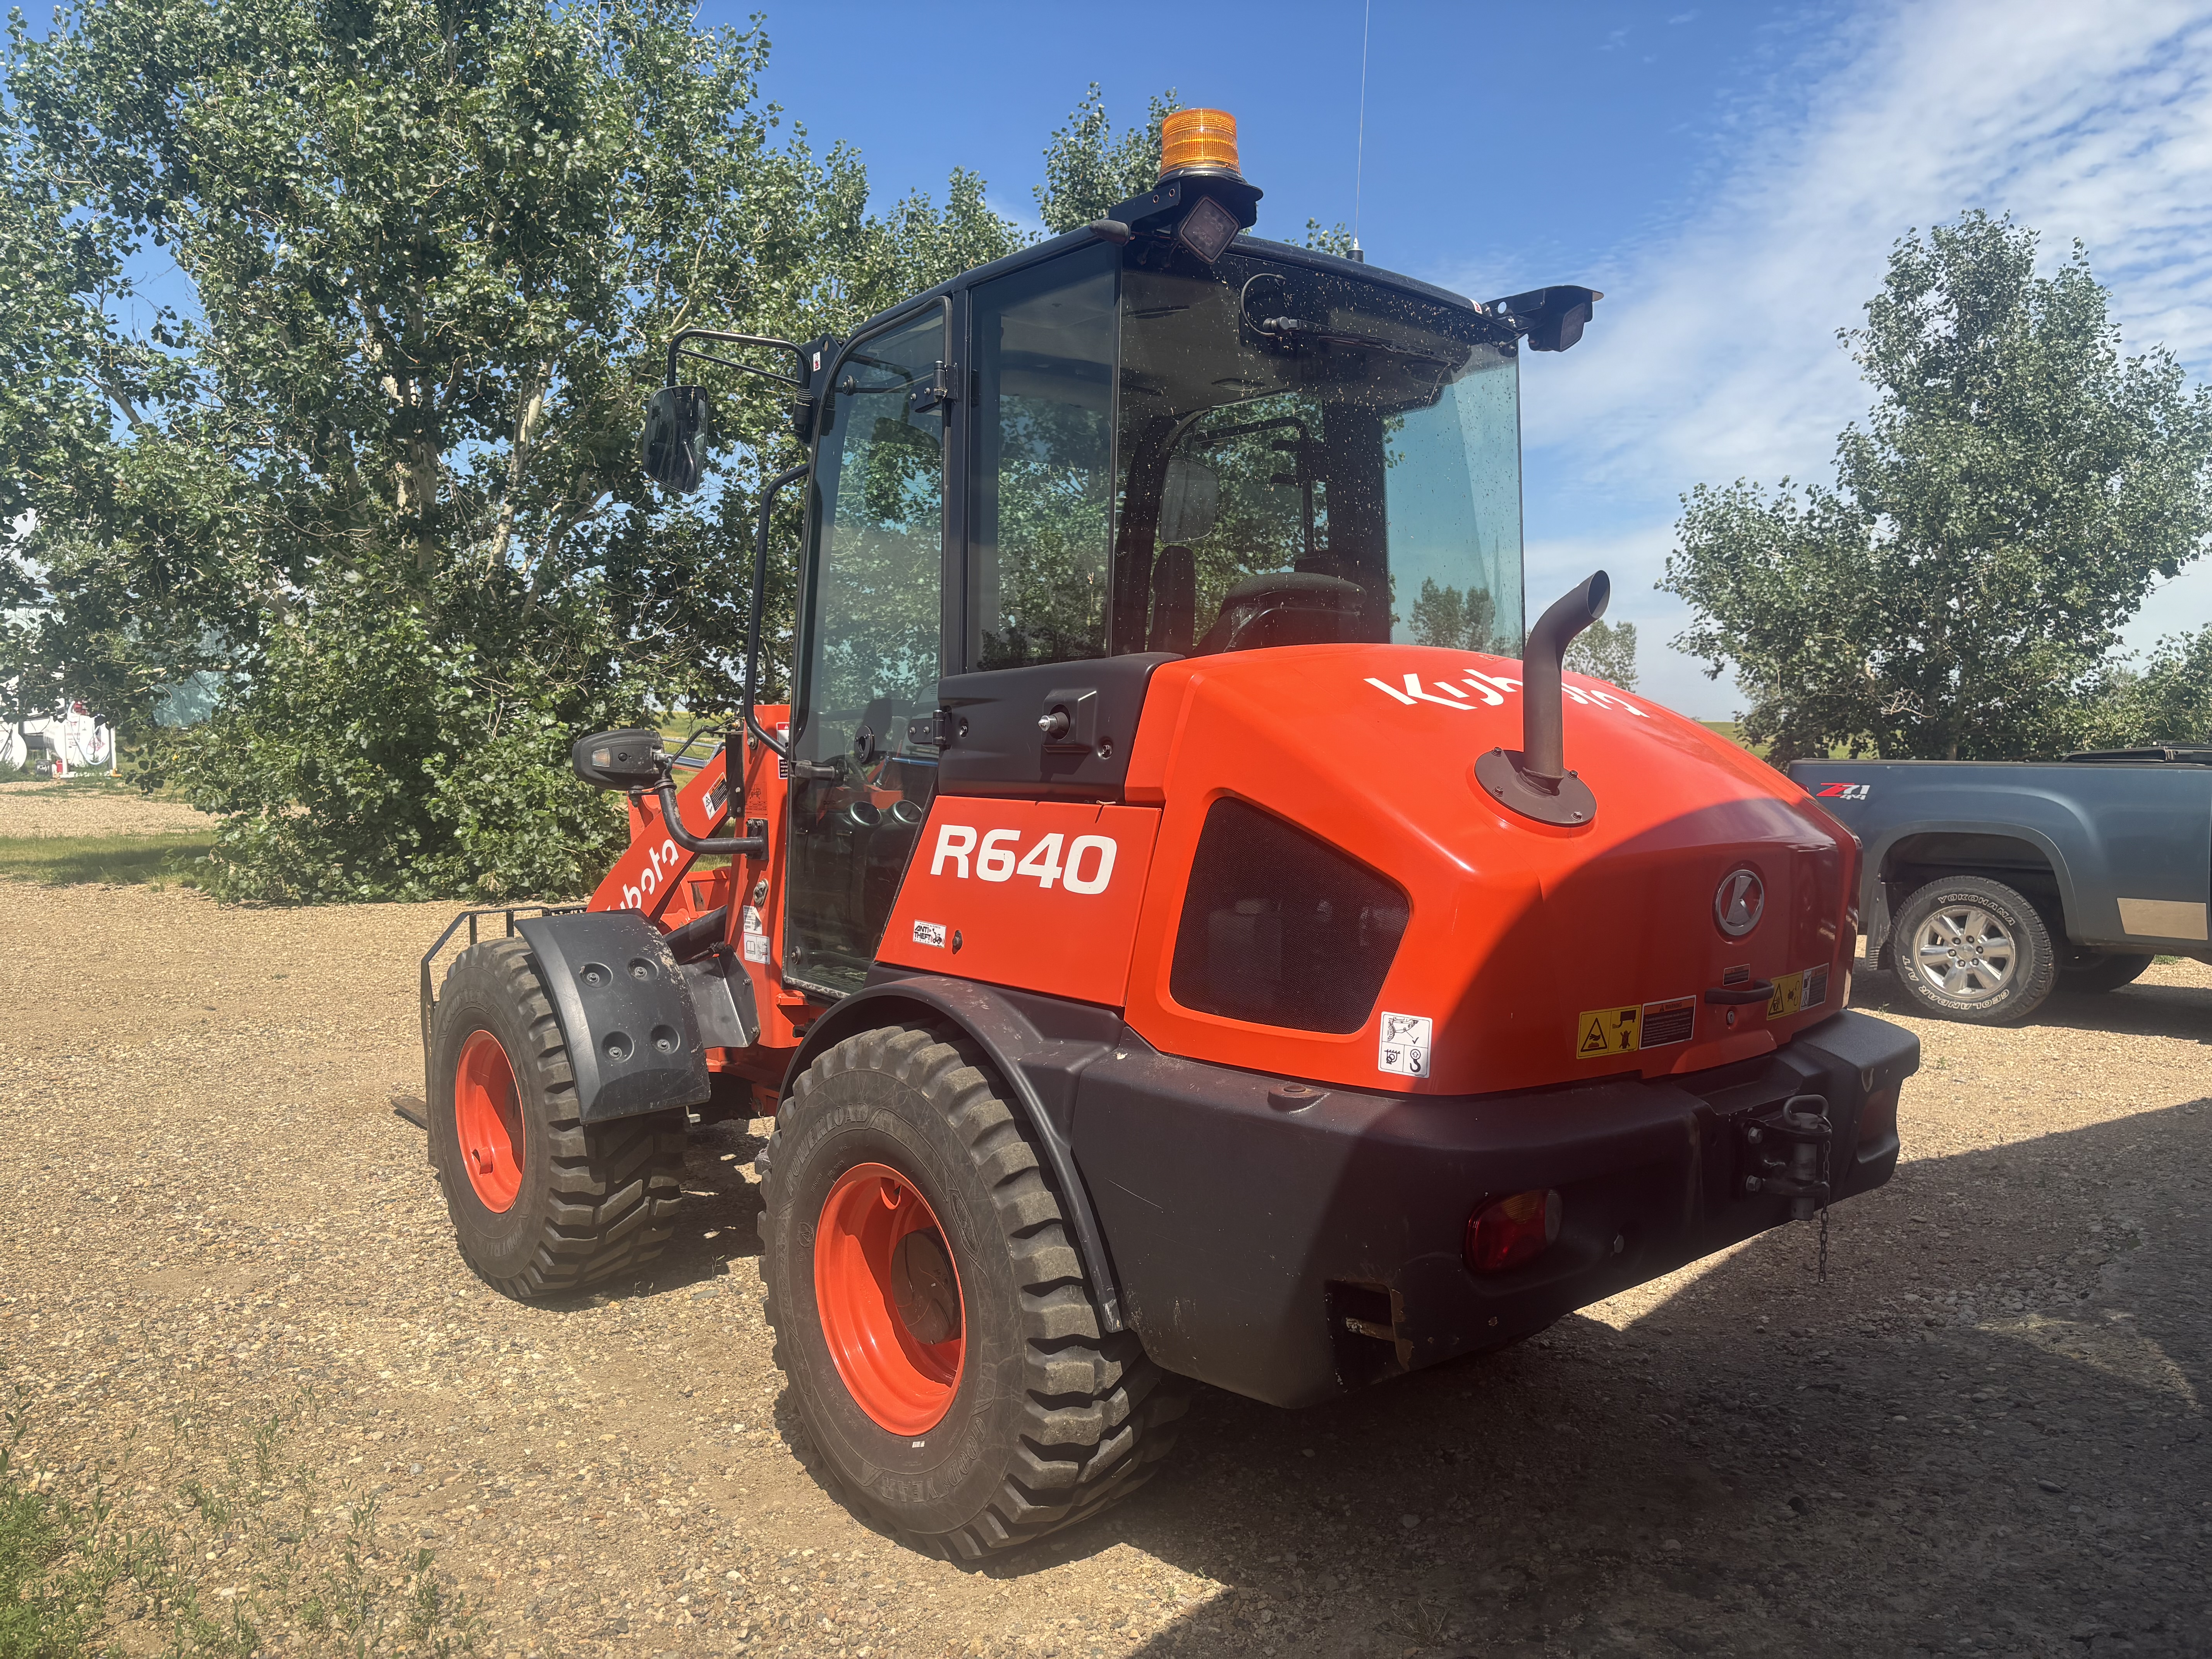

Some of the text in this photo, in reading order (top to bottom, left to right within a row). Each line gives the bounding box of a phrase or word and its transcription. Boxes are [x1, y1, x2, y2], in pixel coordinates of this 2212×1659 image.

[1816, 783, 1870, 797] Z71
[930, 824, 1117, 895] R640
[1937, 893, 2016, 926] YOKOHAMA
[914, 931, 931, 941] THEFT
[915, 925, 929, 934] ANTI
[1902, 955, 1919, 982] A/T
[1918, 985, 2010, 1010] GEOLANDAR
[785, 1103, 869, 1197] POWERLOAD
